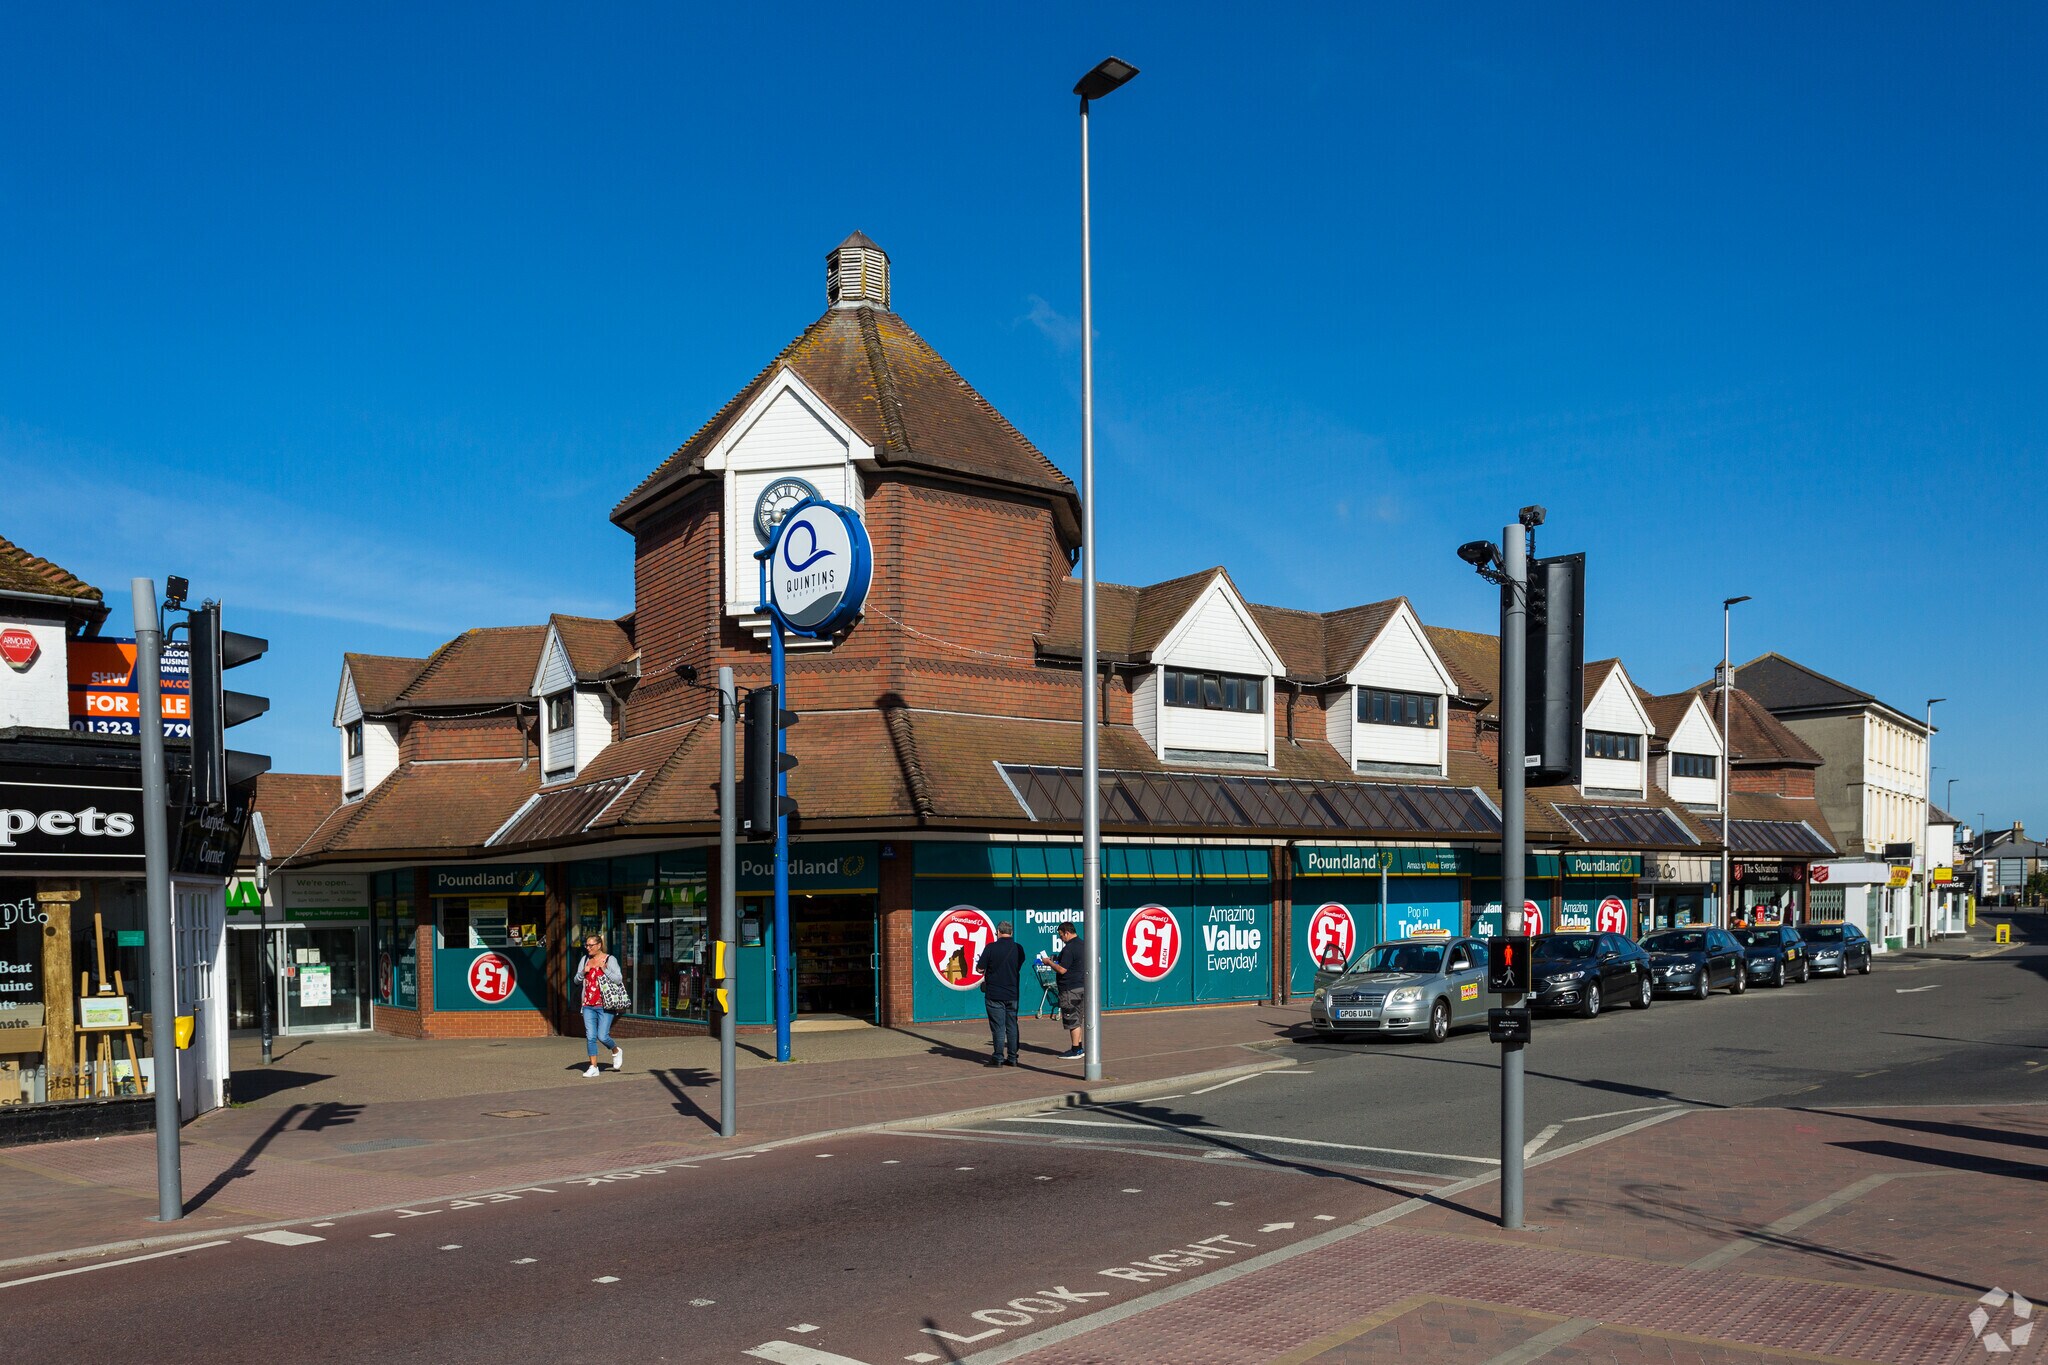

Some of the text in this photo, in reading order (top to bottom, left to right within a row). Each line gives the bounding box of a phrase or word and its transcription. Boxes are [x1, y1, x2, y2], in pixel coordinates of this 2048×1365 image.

[786, 569, 834, 593] QUINTINS
[3, 636, 33, 646] ARMOURY
[91, 671, 128, 684] SHW
[86, 695, 129, 712] FOR
[72, 720, 133, 735] 01323
[0, 806, 135, 847] pets
[200, 840, 226, 863] Corner
[741, 859, 838, 876] Poudland
[1308, 852, 1376, 870] Poundland
[1406, 861, 1426, 871] Amazing
[1426, 861, 1440, 869] Value
[1576, 859, 1620, 872] Poundland
[1743, 863, 1754, 873] The
[1754, 863, 1778, 873] Salvation
[296, 879, 323, 887] We're
[438, 872, 514, 887] Poundland
[1208, 905, 1255, 924] Amazing
[1407, 906, 1429, 918] Pop in
[1563, 902, 1588, 915] Amazing
[950, 915, 978, 925] Poundland
[1141, 913, 1164, 922] Poundland
[1561, 914, 1591, 927] Value
[1601, 906, 1623, 934] £1
[509, 929, 519, 937] 25
[1478, 921, 1494, 937] big
[1131, 919, 1172, 969] £1
[1202, 924, 1261, 952] Value
[1315, 915, 1349, 961] £1
[939, 922, 987, 976] £1
[1207, 952, 1257, 973] Everyday!
[475, 961, 509, 996] £1
[1340, 1009, 1372, 1018] GP06 UAD
[394, 1163, 702, 1219] LOOK LEFT
[919, 1233, 1257, 1344] LOOK RIGHT
